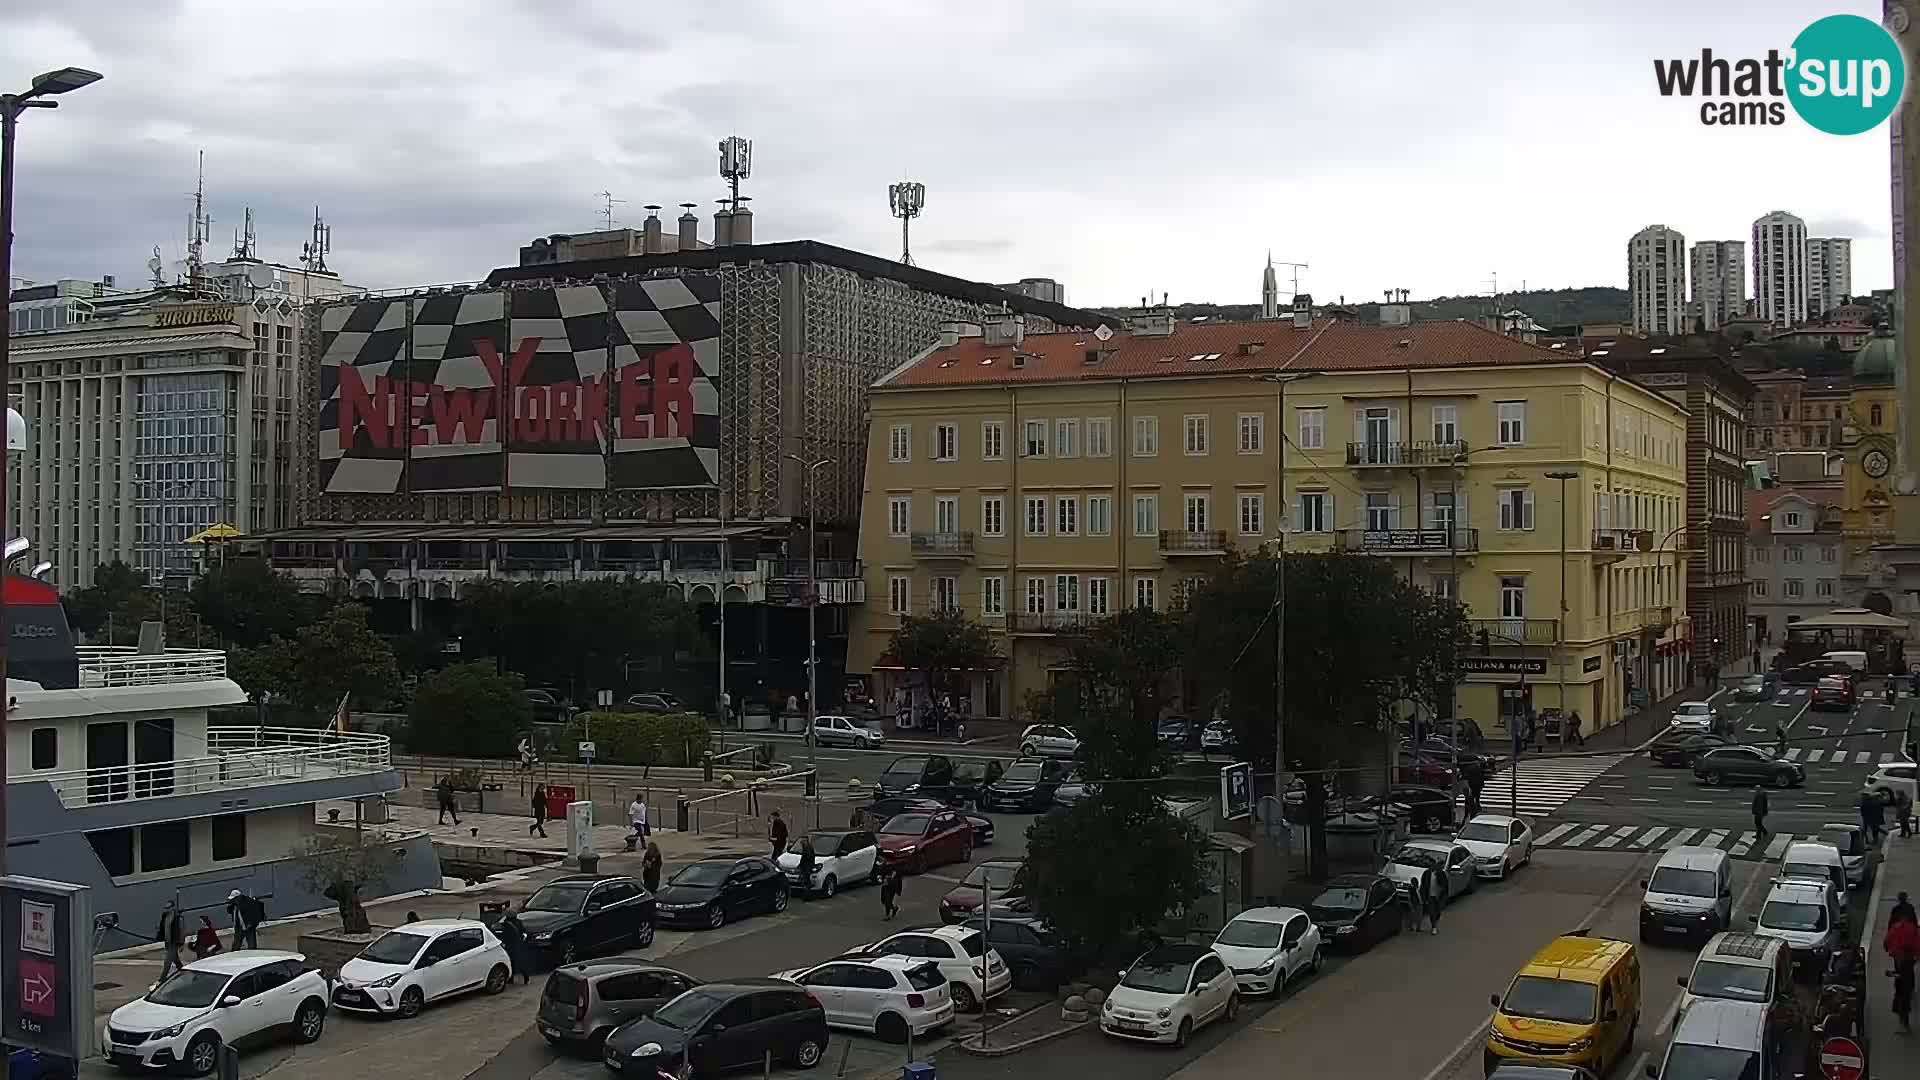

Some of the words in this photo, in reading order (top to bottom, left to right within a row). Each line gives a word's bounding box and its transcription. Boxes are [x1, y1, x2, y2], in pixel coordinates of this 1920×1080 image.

[1459, 660, 1505, 670] JULIANA
[1509, 662, 1541, 671] NAILS
[21, 1018, 28, 1030] 5
[28, 1020, 41, 1032] km
